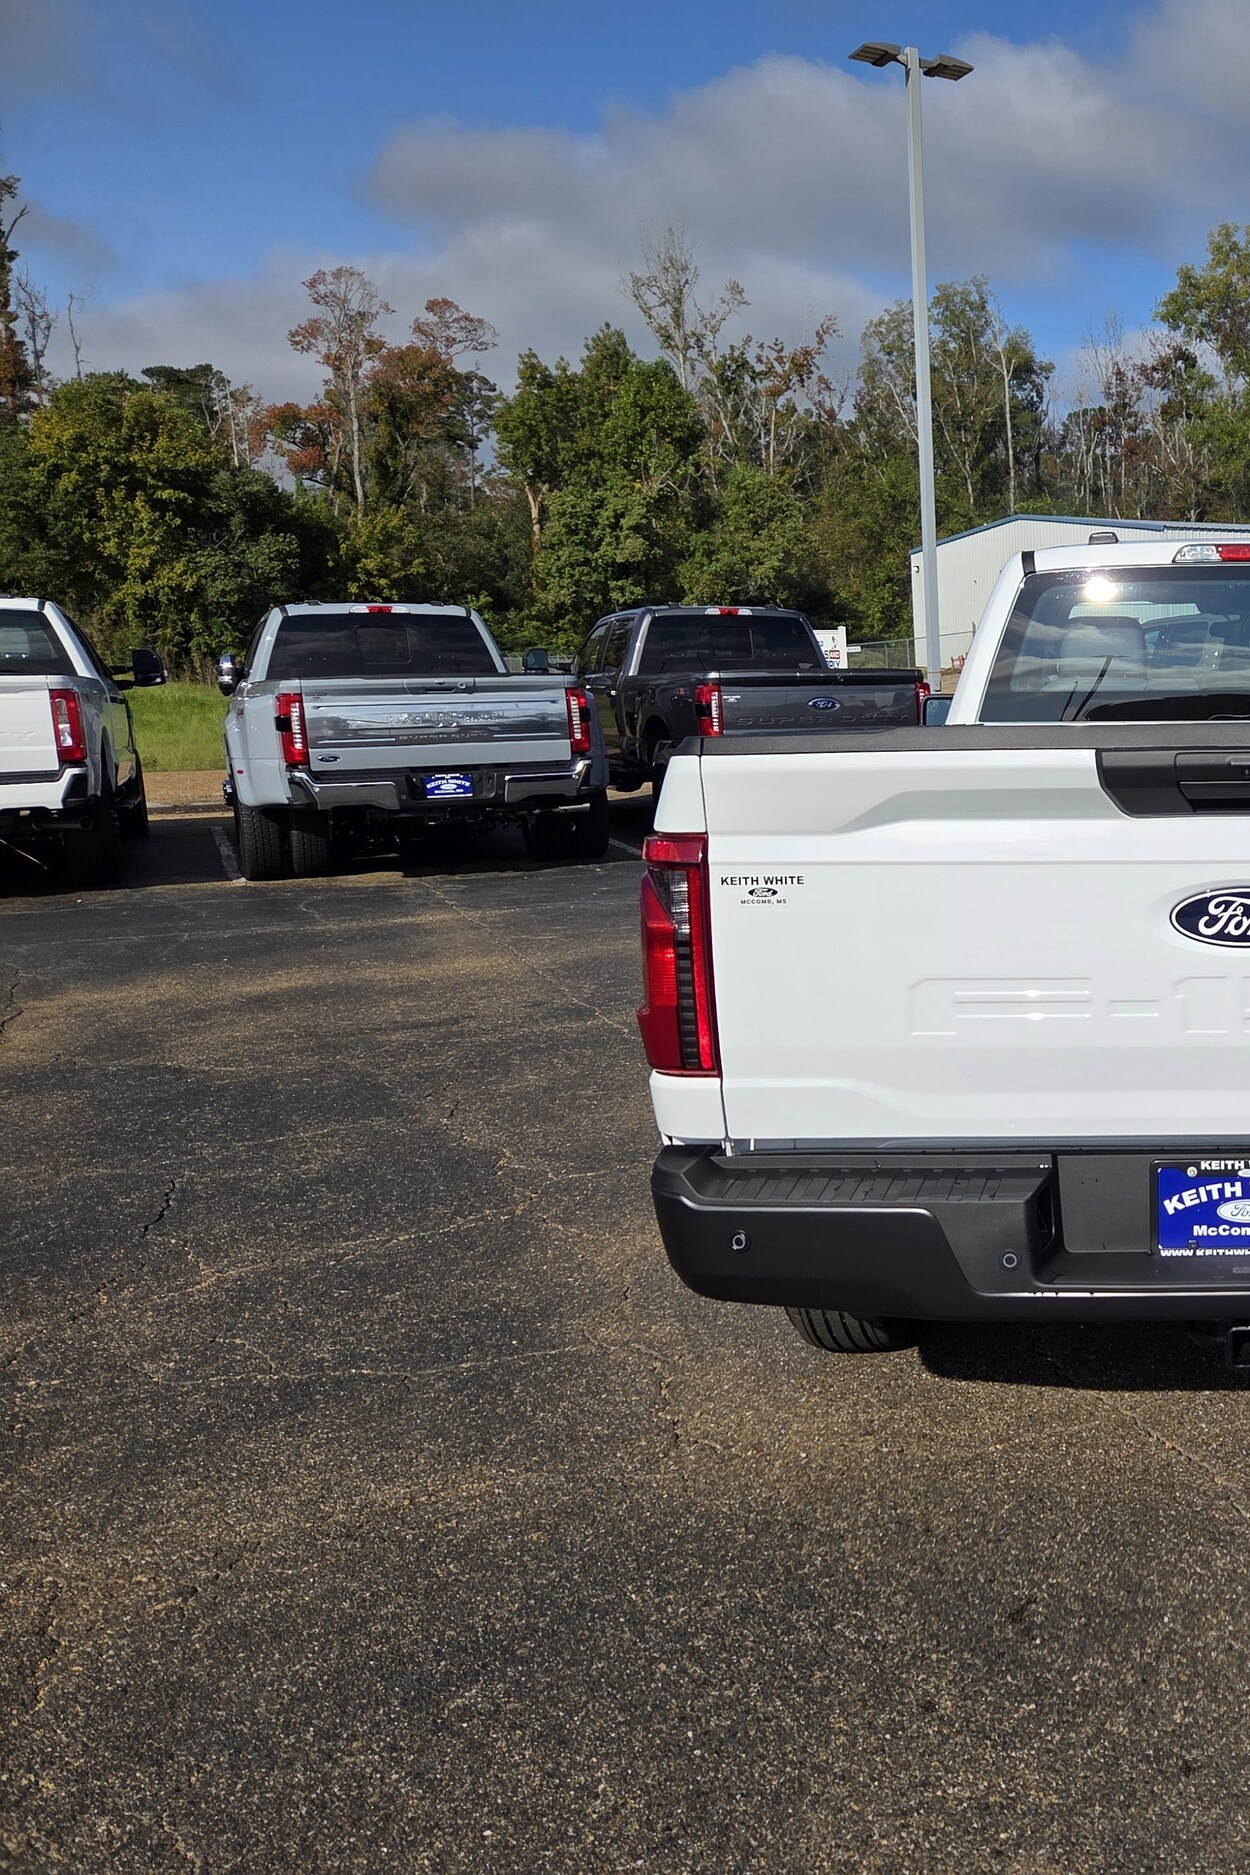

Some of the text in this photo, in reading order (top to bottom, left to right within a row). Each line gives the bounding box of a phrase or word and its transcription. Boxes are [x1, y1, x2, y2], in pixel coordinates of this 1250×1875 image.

[735, 715, 833, 726] SUPER
[426, 779, 471, 789] KEITH WHITE
[720, 875, 805, 886] KEITH WHITE
[752, 888, 775, 897] Ford
[1200, 1160, 1245, 1170] KEITH
[1163, 1181, 1243, 1216] KEITH
